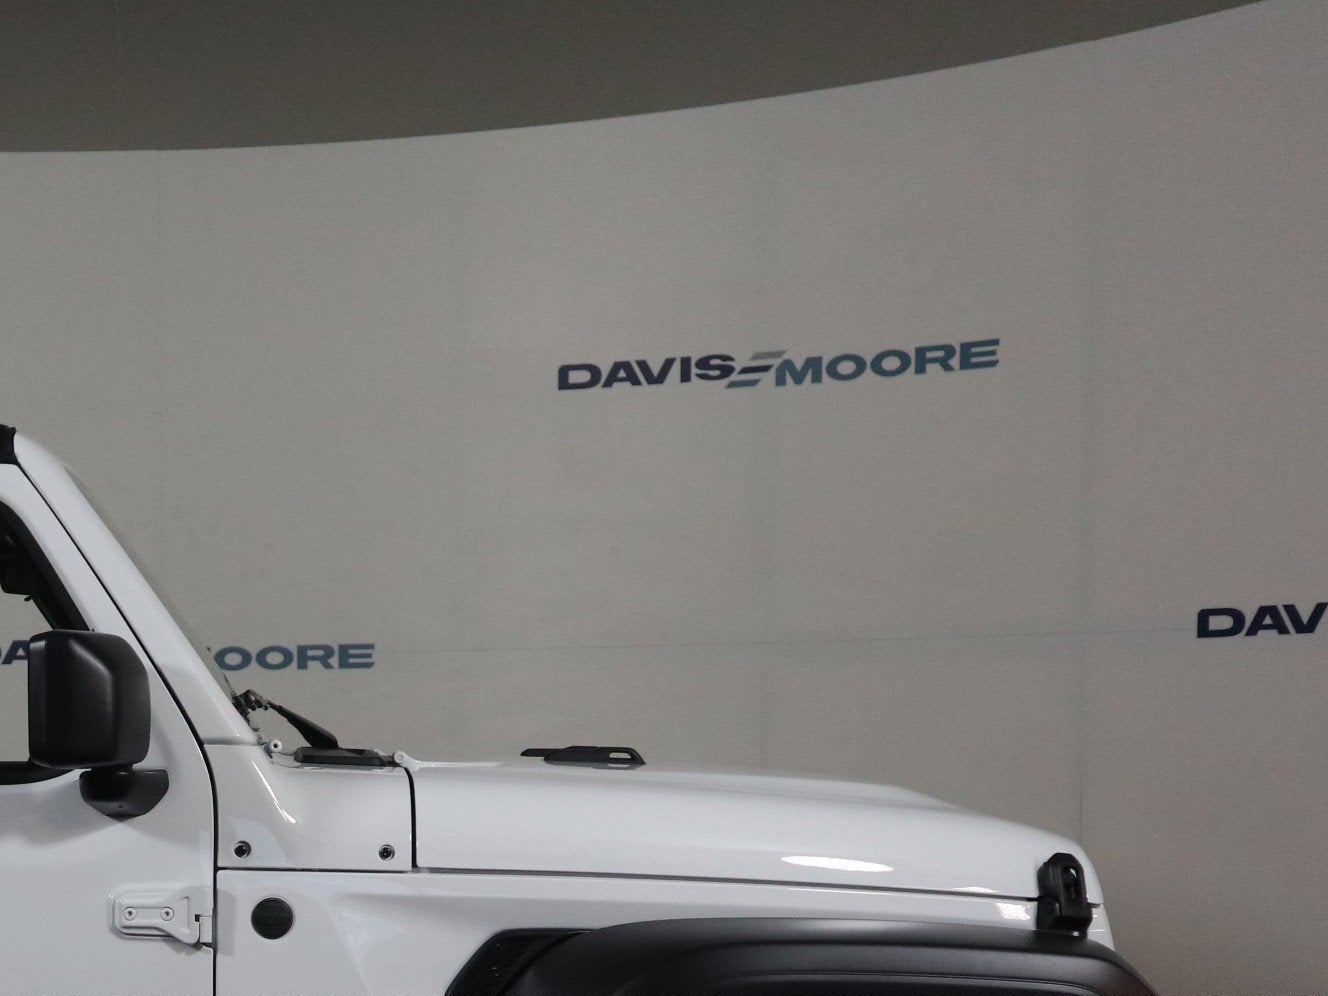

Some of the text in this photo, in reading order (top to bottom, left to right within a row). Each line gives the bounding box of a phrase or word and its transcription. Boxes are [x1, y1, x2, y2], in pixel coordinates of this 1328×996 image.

[558, 338, 1001, 391] DAVIS MOORE
[1197, 602, 1328, 639] DAV
[213, 643, 375, 671] OORE
